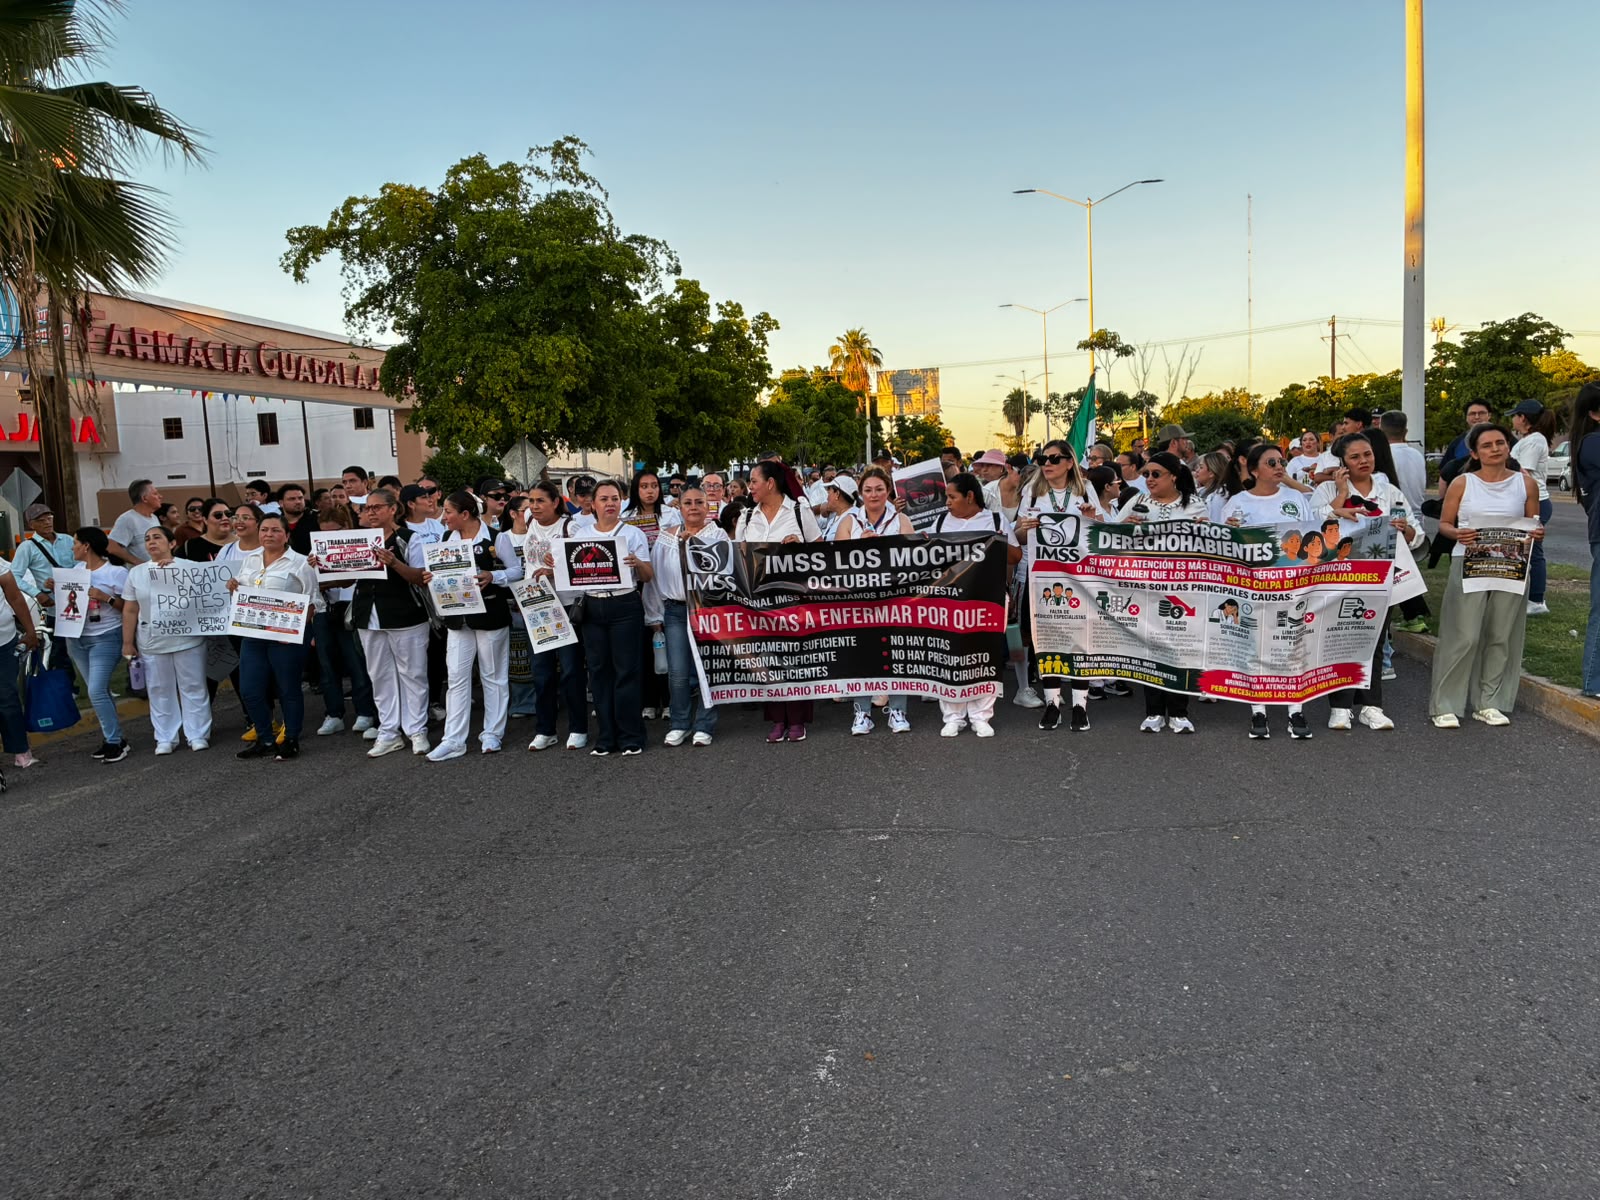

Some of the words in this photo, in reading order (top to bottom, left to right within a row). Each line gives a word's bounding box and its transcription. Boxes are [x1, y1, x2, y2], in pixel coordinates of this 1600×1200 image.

[81, 308, 251, 374] FARMACIA
[1132, 525, 1144, 536] A
[1148, 521, 1232, 540] NUESTROS
[1035, 546, 1080, 563] IMSS
[1098, 531, 1274, 562] DERECHOHABIENTES
[765, 552, 827, 575] IMSS
[835, 549, 881, 570] LOS
[889, 542, 986, 568] MOCHIS
[1077, 566, 1082, 574] O
[1084, 565, 1096, 575] NO
[1097, 567, 1113, 577] HAY
[1114, 568, 1149, 579] ALGUIEN
[1151, 570, 1167, 581] QUE
[1169, 570, 1186, 580] LOS
[1187, 571, 1225, 583] ATIENDA,
[1226, 574, 1239, 585] NO
[1240, 576, 1251, 587] ES
[1253, 578, 1281, 590] CULPA
[1284, 578, 1294, 588] DE
[1295, 576, 1309, 587] LOS
[1310, 573, 1381, 585] TRABAJADORES.
[1089, 557, 1098, 566] SI
[1099, 558, 1116, 568] HOY
[1118, 559, 1130, 568] LA
[1131, 558, 1174, 570] ATENCIÓN
[1176, 561, 1187, 570] ES
[1189, 560, 1207, 571] MÁS
[1209, 562, 1235, 575] LENTA,
[1236, 567, 1251, 577] HAY
[1252, 569, 1283, 580] DÉFICIT
[1285, 569, 1296, 579] EN
[1299, 567, 1311, 576] LOS
[1312, 562, 1352, 575] SERVICIOS
[178, 583, 212, 596] BAJO
[687, 573, 737, 592] IMSS
[807, 572, 892, 590] OCTUBRE
[157, 592, 232, 609] PROTEST
[727, 592, 773, 608] PERSONAL
[775, 594, 800, 605] IMSS
[880, 588, 907, 598] BAJO
[1118, 581, 1146, 590] ESTAS
[1148, 583, 1169, 592] SON
[1171, 583, 1190, 592] LAS
[1191, 584, 1249, 599] PRINCIPALES
[1251, 592, 1293, 602] CAUSAS:
[152, 620, 187, 629] SALARIO
[197, 616, 226, 625] RETIRO
[699, 614, 721, 634] NO
[724, 612, 744, 632] TE
[747, 613, 800, 632] VAYAS
[804, 610, 816, 630] A
[819, 604, 913, 627] ENFERMAR
[917, 605, 949, 627] POR
[160, 627, 192, 635] JUSTO
[200, 624, 225, 633] DIGNO
[1228, 630, 1249, 640] TRABAJO
[712, 644, 732, 656] HAY
[733, 641, 800, 655] MEDICAMENTO
[802, 636, 857, 651] SUFICIENTE
[890, 635, 904, 646] NO
[906, 636, 925, 647] HAY
[927, 636, 950, 651] CITAS
[712, 659, 734, 670] HAY
[734, 656, 782, 669] PERSONAL
[782, 651, 837, 666] SUFICIENTE
[891, 649, 906, 660] NO
[907, 650, 926, 661] HAY
[928, 651, 990, 667] PRESUPUESTO
[1086, 656, 1130, 664] TRABAJADORES
[1142, 661, 1157, 669] IMSS
[712, 672, 733, 684] HAY
[734, 671, 767, 683] CAMAS
[768, 666, 829, 682] SUFICIENTES
[892, 663, 905, 675] SE
[906, 664, 951, 680] CANCELAN
[953, 665, 997, 682] CIRUGÍAS
[1080, 668, 1114, 676] ESTAMOS
[1116, 669, 1131, 677] CON
[1133, 673, 1165, 686] USTEDES.
[1121, 663, 1178, 682] DERECHOHABIENTES
[1231, 672, 1258, 684] NUESTRO
[750, 688, 764, 698] DE
[767, 685, 811, 698] SALARIO
[814, 683, 844, 696] REAL,
[846, 682, 862, 693] NO
[865, 681, 888, 691] MAS
[891, 681, 930, 692] DINERO
[931, 684, 938, 693] A
[939, 685, 957, 698] LAS
[1210, 684, 1228, 693] PERO
[1229, 687, 1273, 698] NECESITAMOS
[1273, 690, 1286, 699] LAS
[1265, 682, 1296, 691] ATENCIÓN
